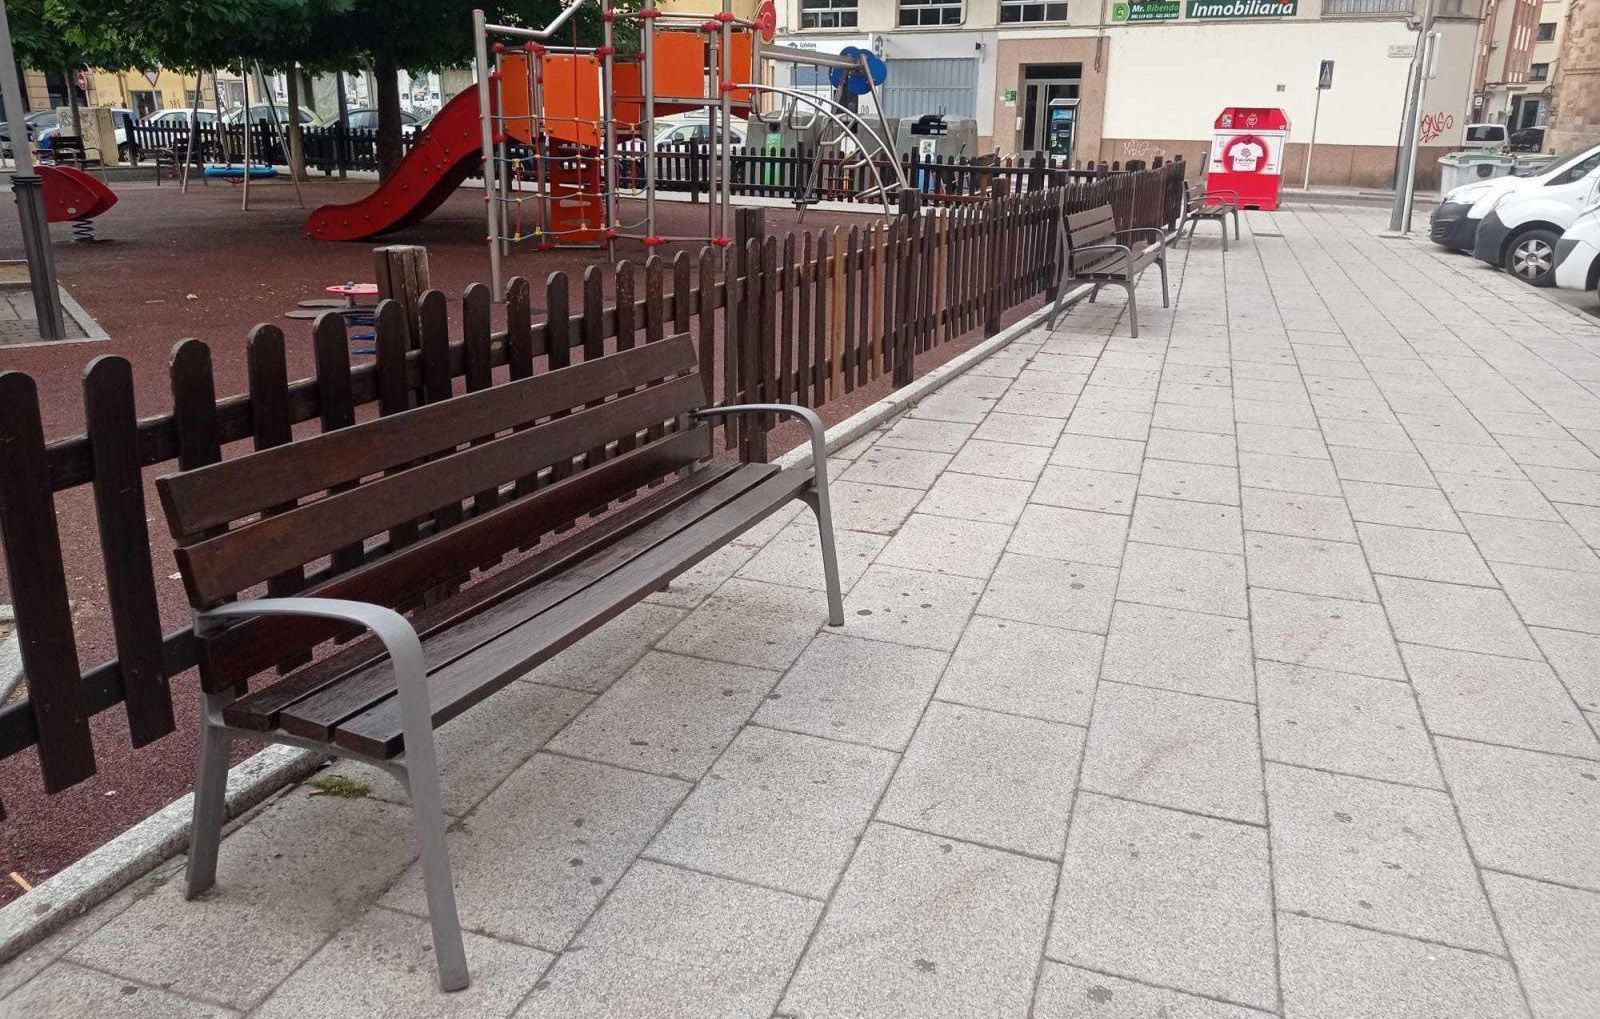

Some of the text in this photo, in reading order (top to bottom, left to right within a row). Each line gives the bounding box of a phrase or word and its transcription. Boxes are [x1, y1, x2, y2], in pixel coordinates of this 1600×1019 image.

[1131, 3, 1179, 13] Mr. Bibendo
[1191, 0, 1294, 17] Inmobiliaria
